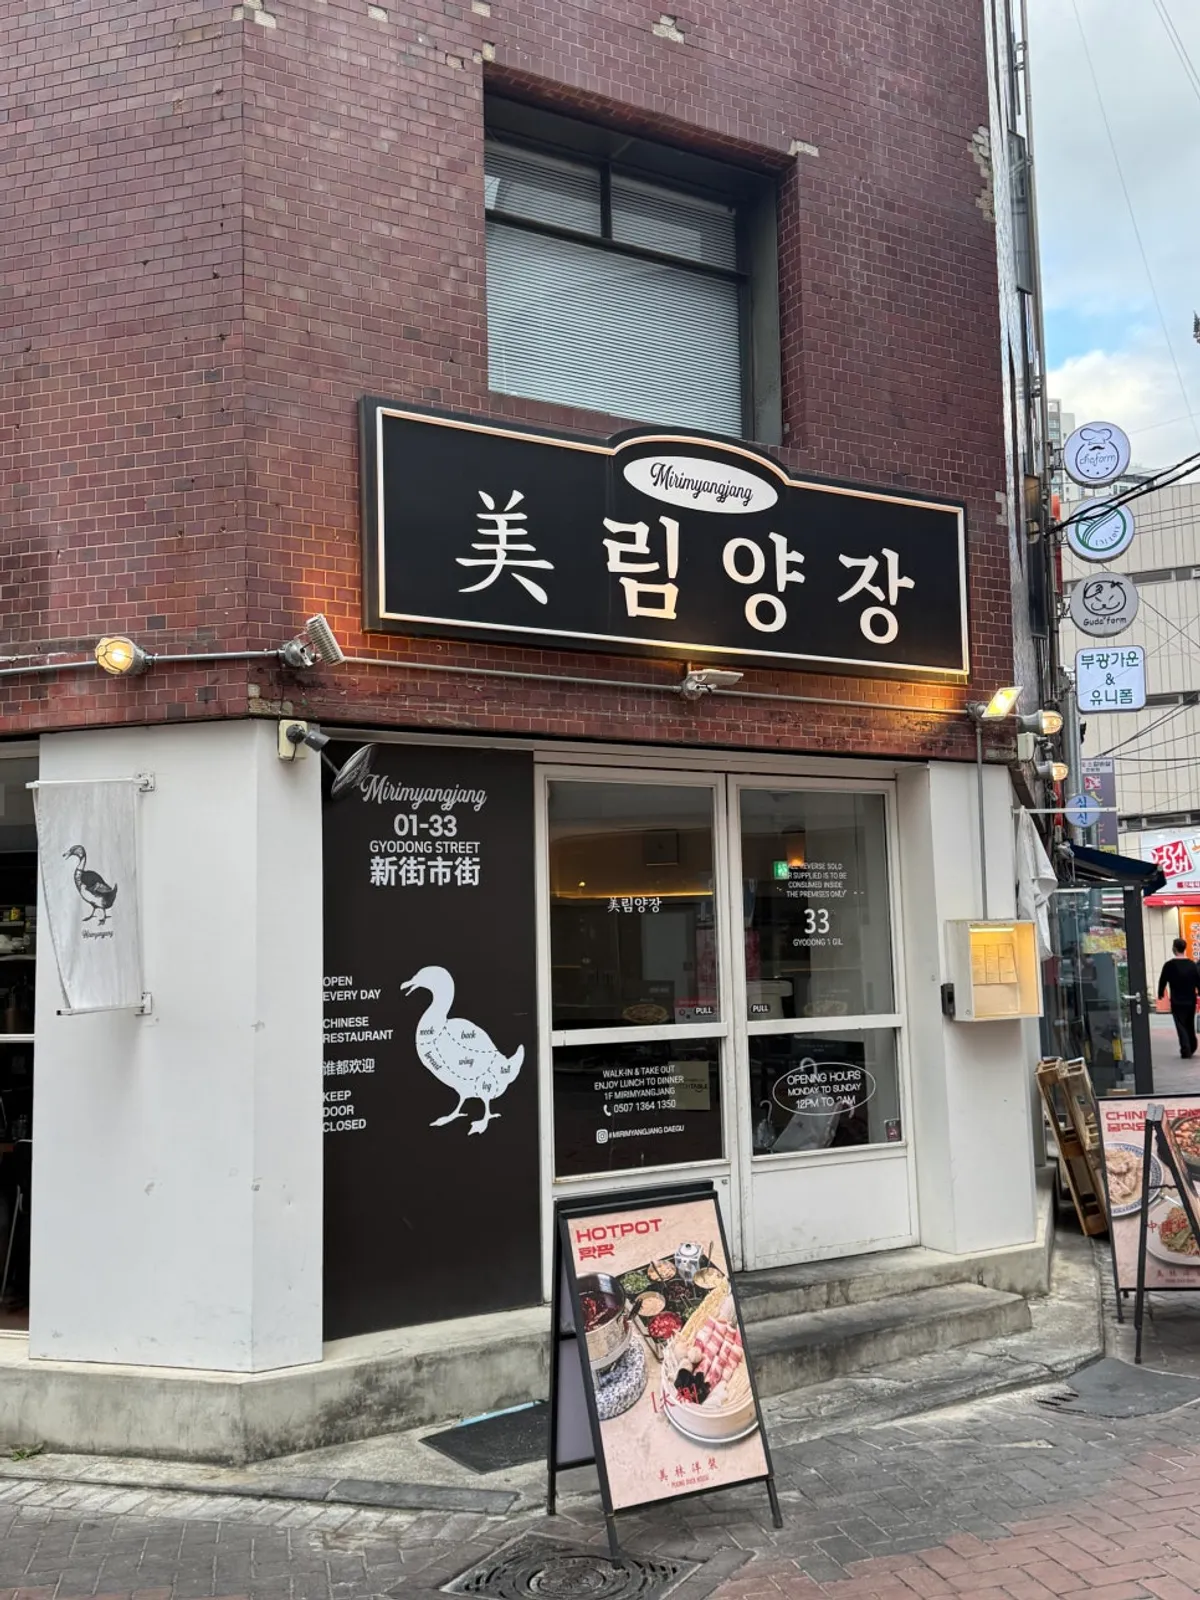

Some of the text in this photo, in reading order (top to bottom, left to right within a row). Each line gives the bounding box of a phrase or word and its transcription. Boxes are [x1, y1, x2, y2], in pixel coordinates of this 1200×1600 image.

[650, 462, 754, 506] Mirimyangjang
[1081, 650, 1139, 670] 부광가운
[1105, 672, 1115, 686] &
[1090, 688, 1133, 706] 유니폼
[360, 774, 487, 811] Mirimyangjang
[393, 813, 458, 838] 01-33
[369, 840, 480, 854] GYODONG STREET
[369, 856, 480, 887] 新街市街
[786, 890, 799, 898] THE
[804, 908, 830, 934] 33
[322, 976, 353, 987] OPEN
[322, 989, 381, 1001] EVERY DAY
[695, 1007, 713, 1015] PULL
[752, 1004, 769, 1012] PULL
[322, 1017, 369, 1029] CHINESE
[322, 1029, 393, 1043] RESTAURANT
[460, 1030, 476, 1039] back
[424, 1050, 442, 1071] breast
[458, 1056, 475, 1068] wing
[602, 1065, 675, 1078] WALK-IN & TAKE OUT
[787, 1070, 861, 1085] OPENING HOURS
[481, 1081, 492, 1092] leg
[594, 1081, 619, 1091] ENJOY
[619, 1079, 645, 1088] LUNCH
[646, 1077, 656, 1085] TO
[657, 1075, 684, 1084] DINNER
[787, 1083, 861, 1096] MONDAY TO SUNDAY
[322, 1090, 352, 1102] KEEP
[604, 1087, 676, 1101] 1F MIRIMYANGJANG
[613, 1103, 634, 1113] 0507
[657, 1100, 676, 1109] 1350
[796, 1098, 819, 1109] 12PM
[820, 1097, 834, 1107] TO
[322, 1105, 354, 1117] DOOR
[1106, 1109, 1175, 1120] CHINE
[322, 1119, 367, 1132] CLOSED
[576, 1218, 662, 1243] HOTPOT
